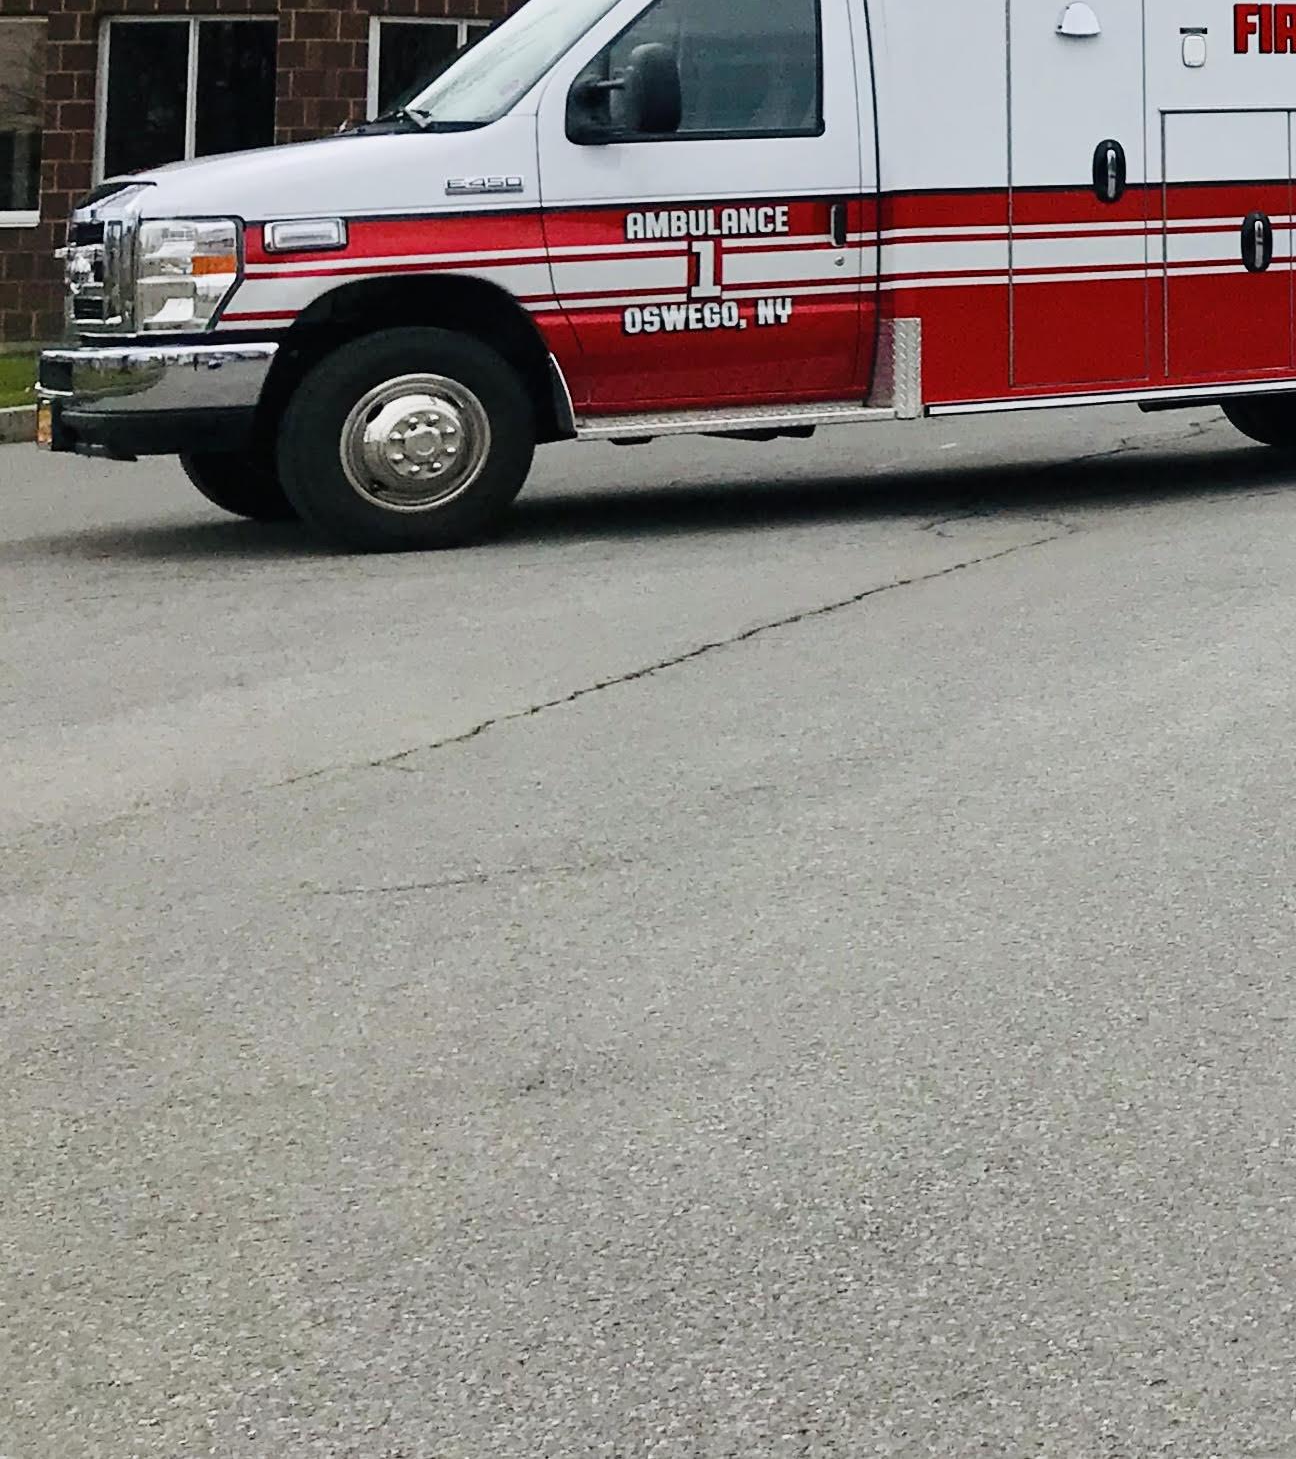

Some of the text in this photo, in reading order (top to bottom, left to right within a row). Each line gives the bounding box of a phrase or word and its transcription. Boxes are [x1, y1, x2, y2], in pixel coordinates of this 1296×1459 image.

[626, 206, 789, 239] AMBULANCE
[691, 240, 721, 298] 1
[624, 298, 792, 334] OSWEGO, NY
